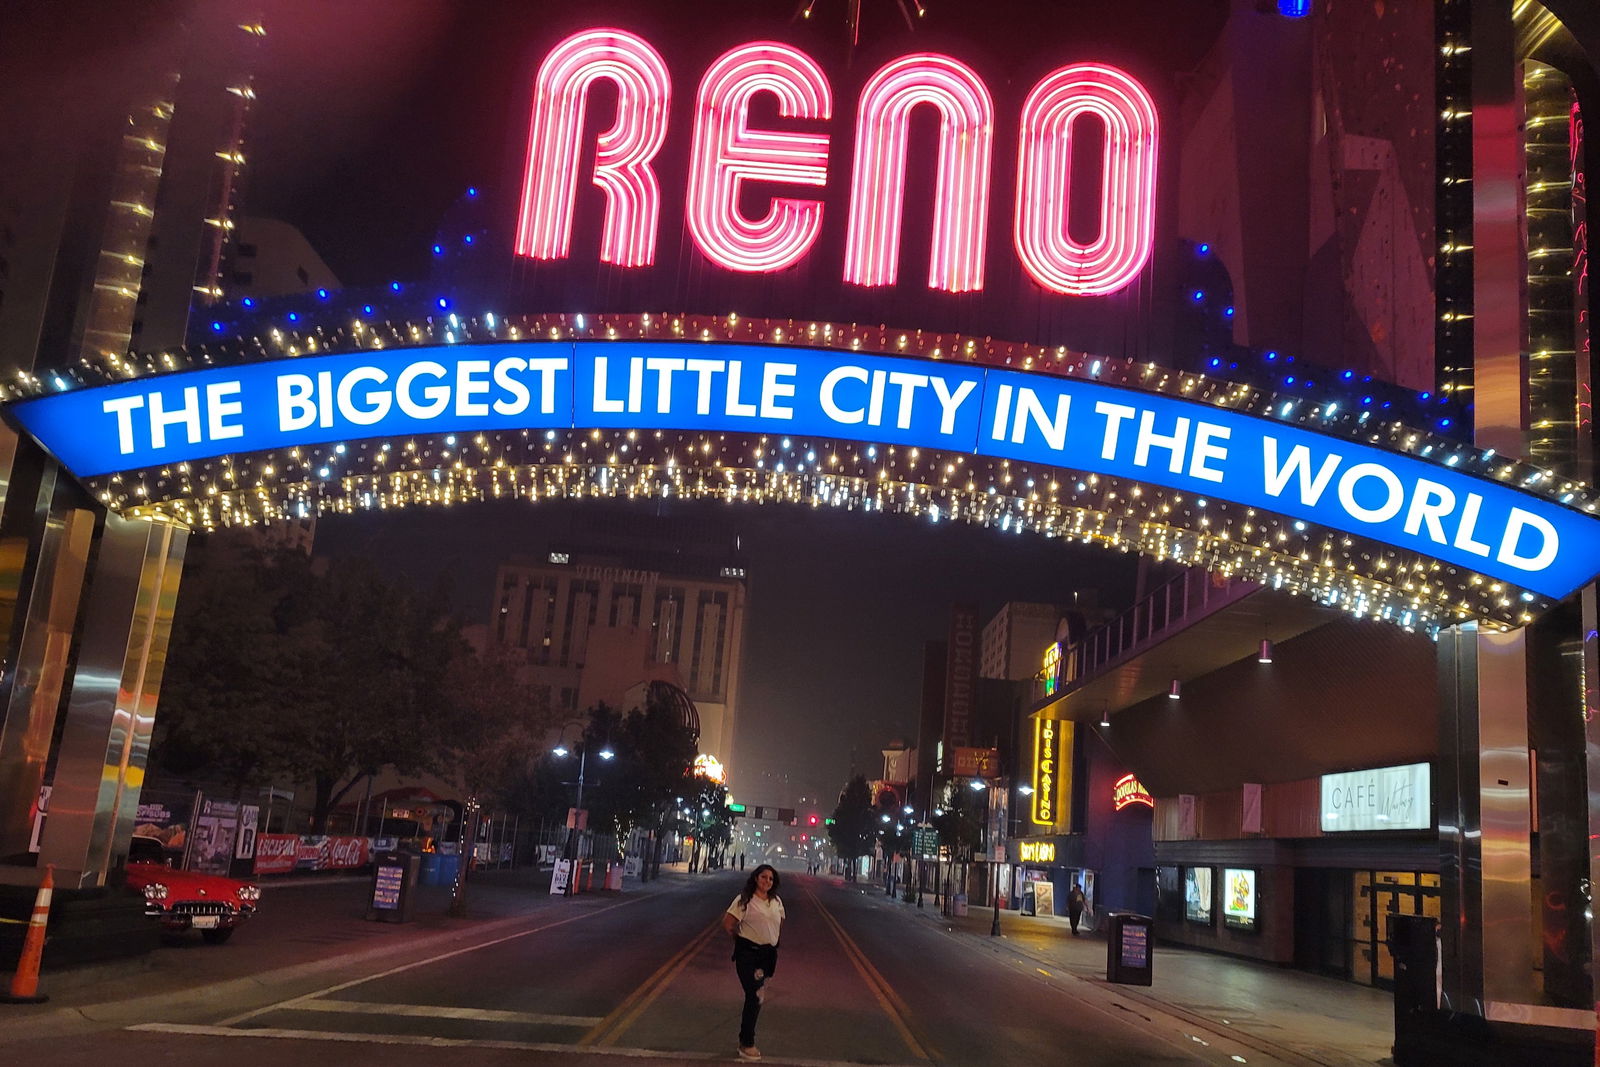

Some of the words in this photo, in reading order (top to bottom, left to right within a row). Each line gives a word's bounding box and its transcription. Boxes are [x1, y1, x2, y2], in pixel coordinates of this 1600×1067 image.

[514, 27, 1161, 297] RENO
[103, 381, 245, 456] THE
[277, 356, 569, 432] BIGGEST
[593, 356, 797, 421] LITTLE
[818, 369, 977, 435] CITY
[991, 384, 1072, 451] IN
[1095, 400, 1232, 484] THE
[1263, 434, 1561, 572] WORLD
[576, 564, 661, 585] VIRGINIAN
[1040, 759, 1054, 820] CASINO
[1116, 780, 1138, 801] DOUGLAS
[1331, 778, 1376, 810] CAFÉ
